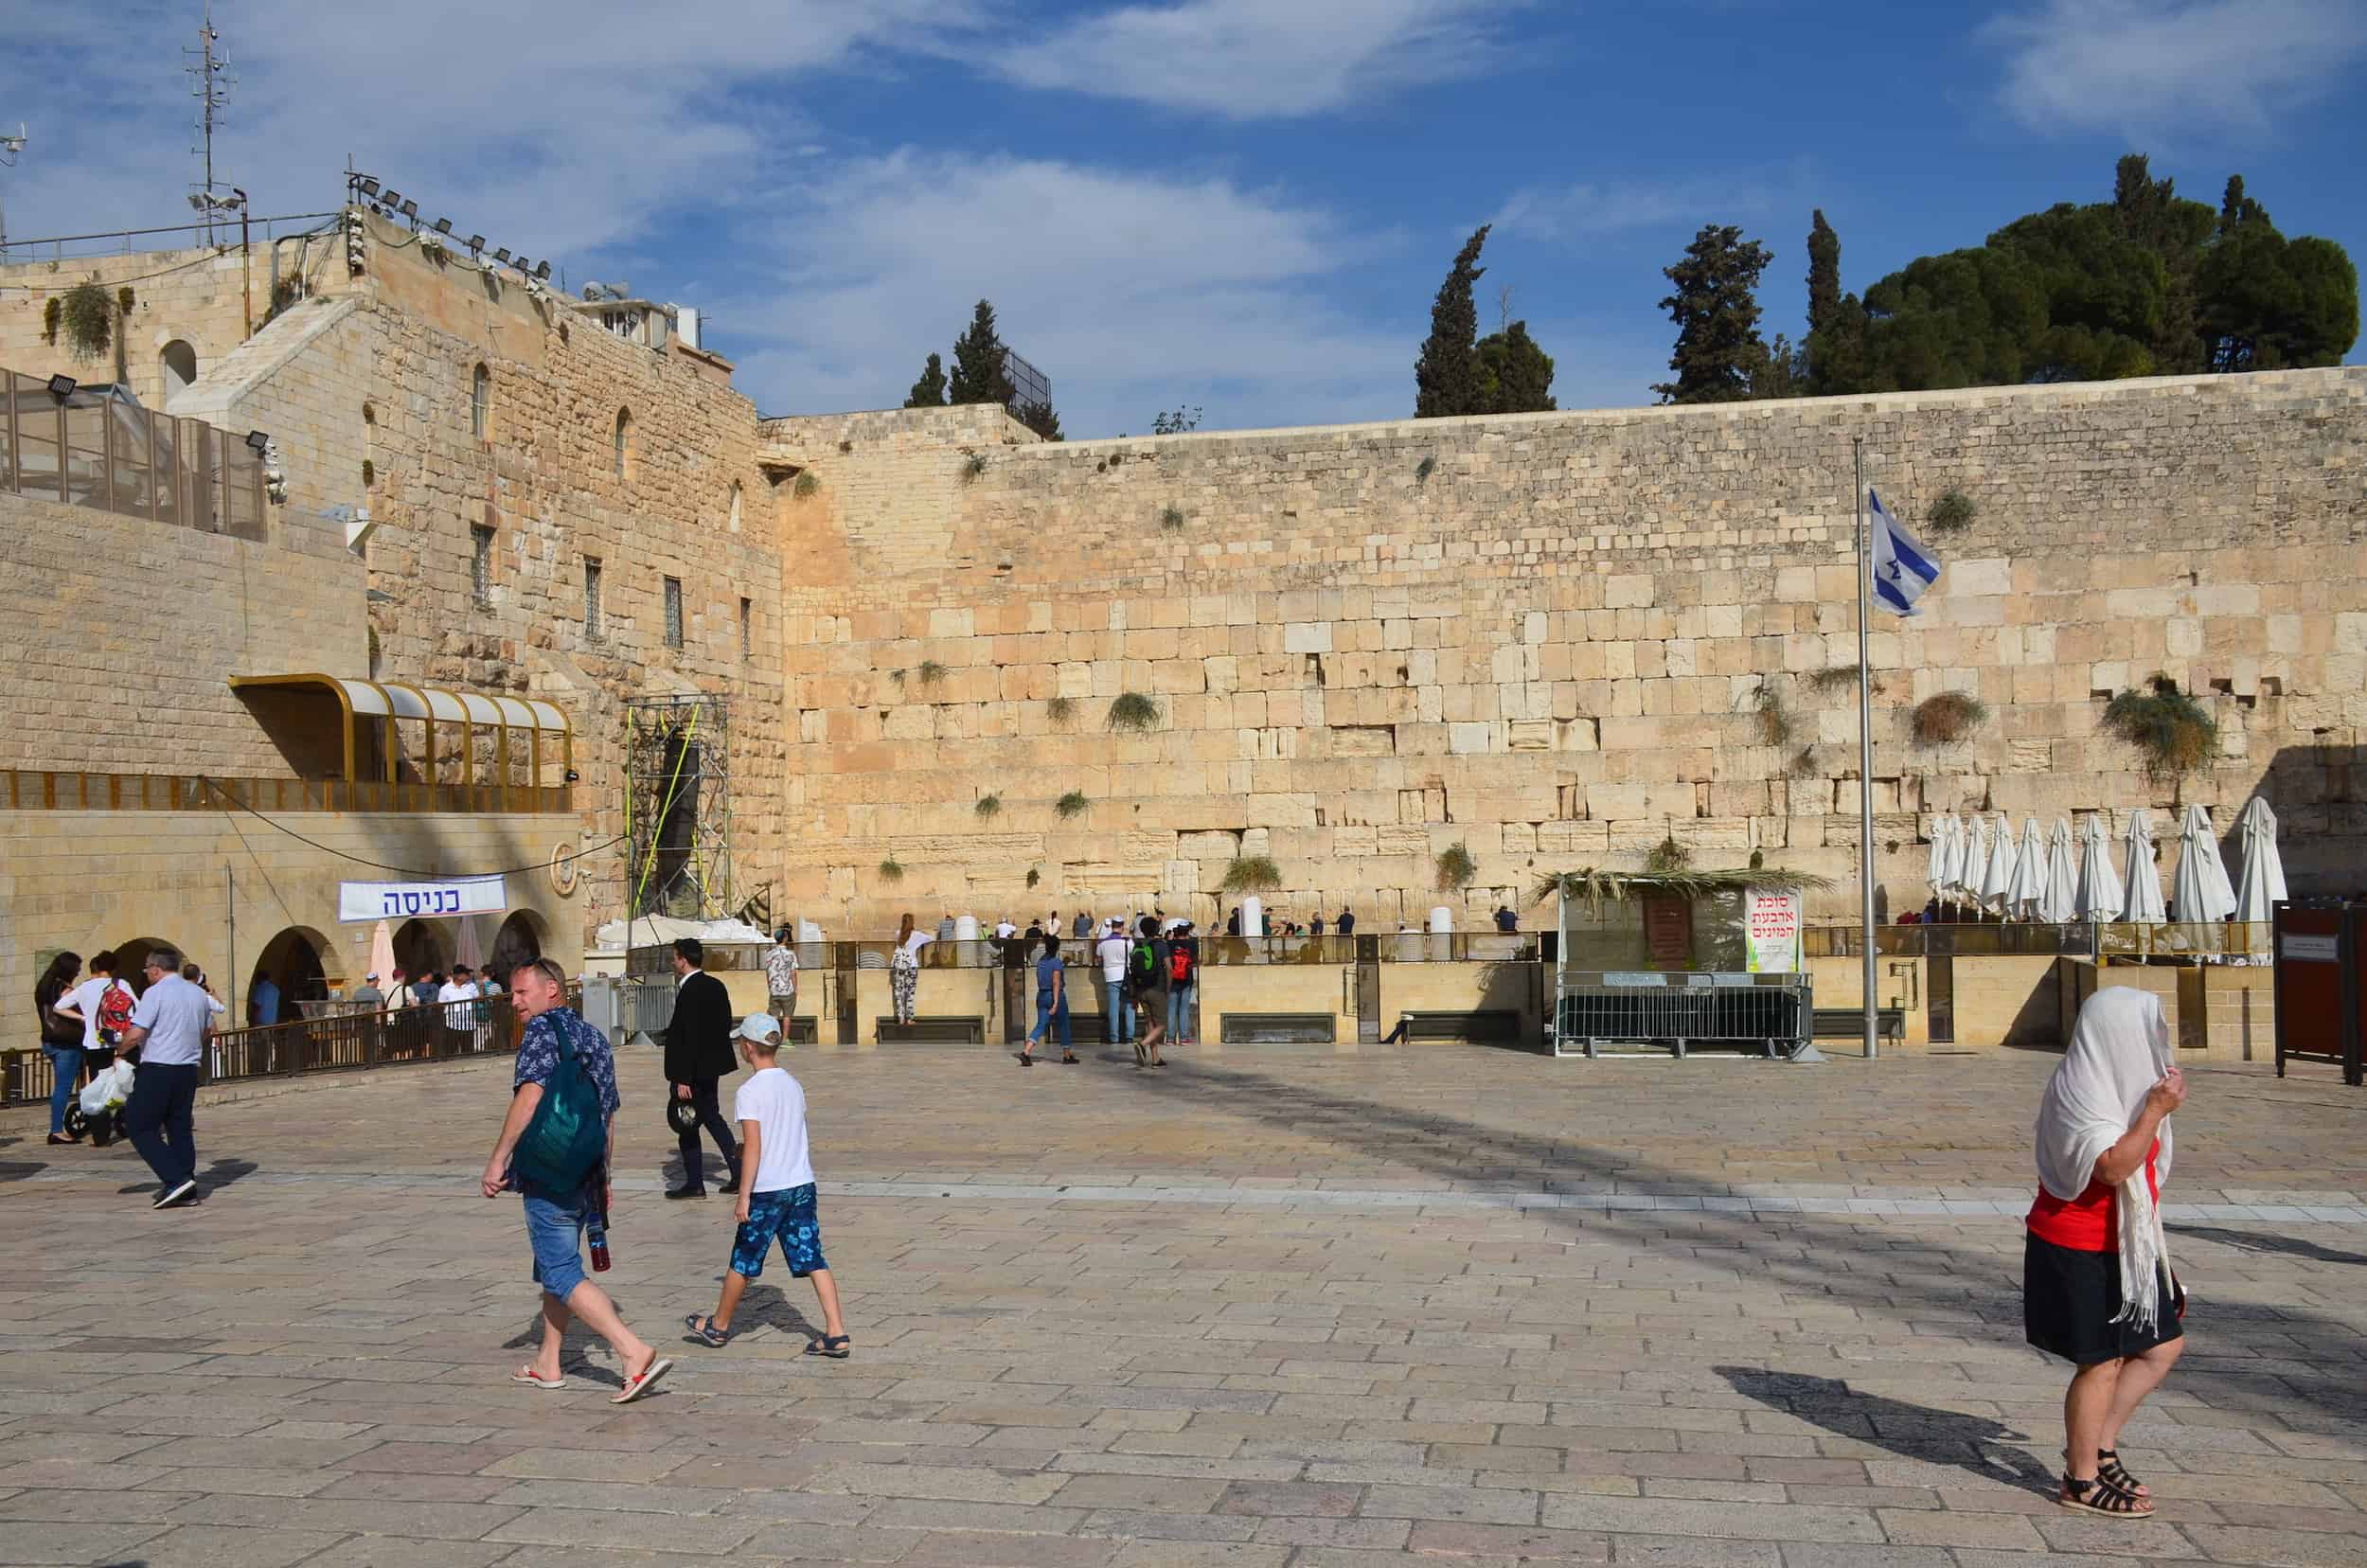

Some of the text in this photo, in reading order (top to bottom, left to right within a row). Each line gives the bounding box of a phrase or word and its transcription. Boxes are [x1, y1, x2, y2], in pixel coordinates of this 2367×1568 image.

[383, 889, 460, 916] כניסה
[1757, 897, 1788, 908] סוכת
[1752, 911, 1794, 923] ארבעת
[1753, 927, 1794, 937] המינים
